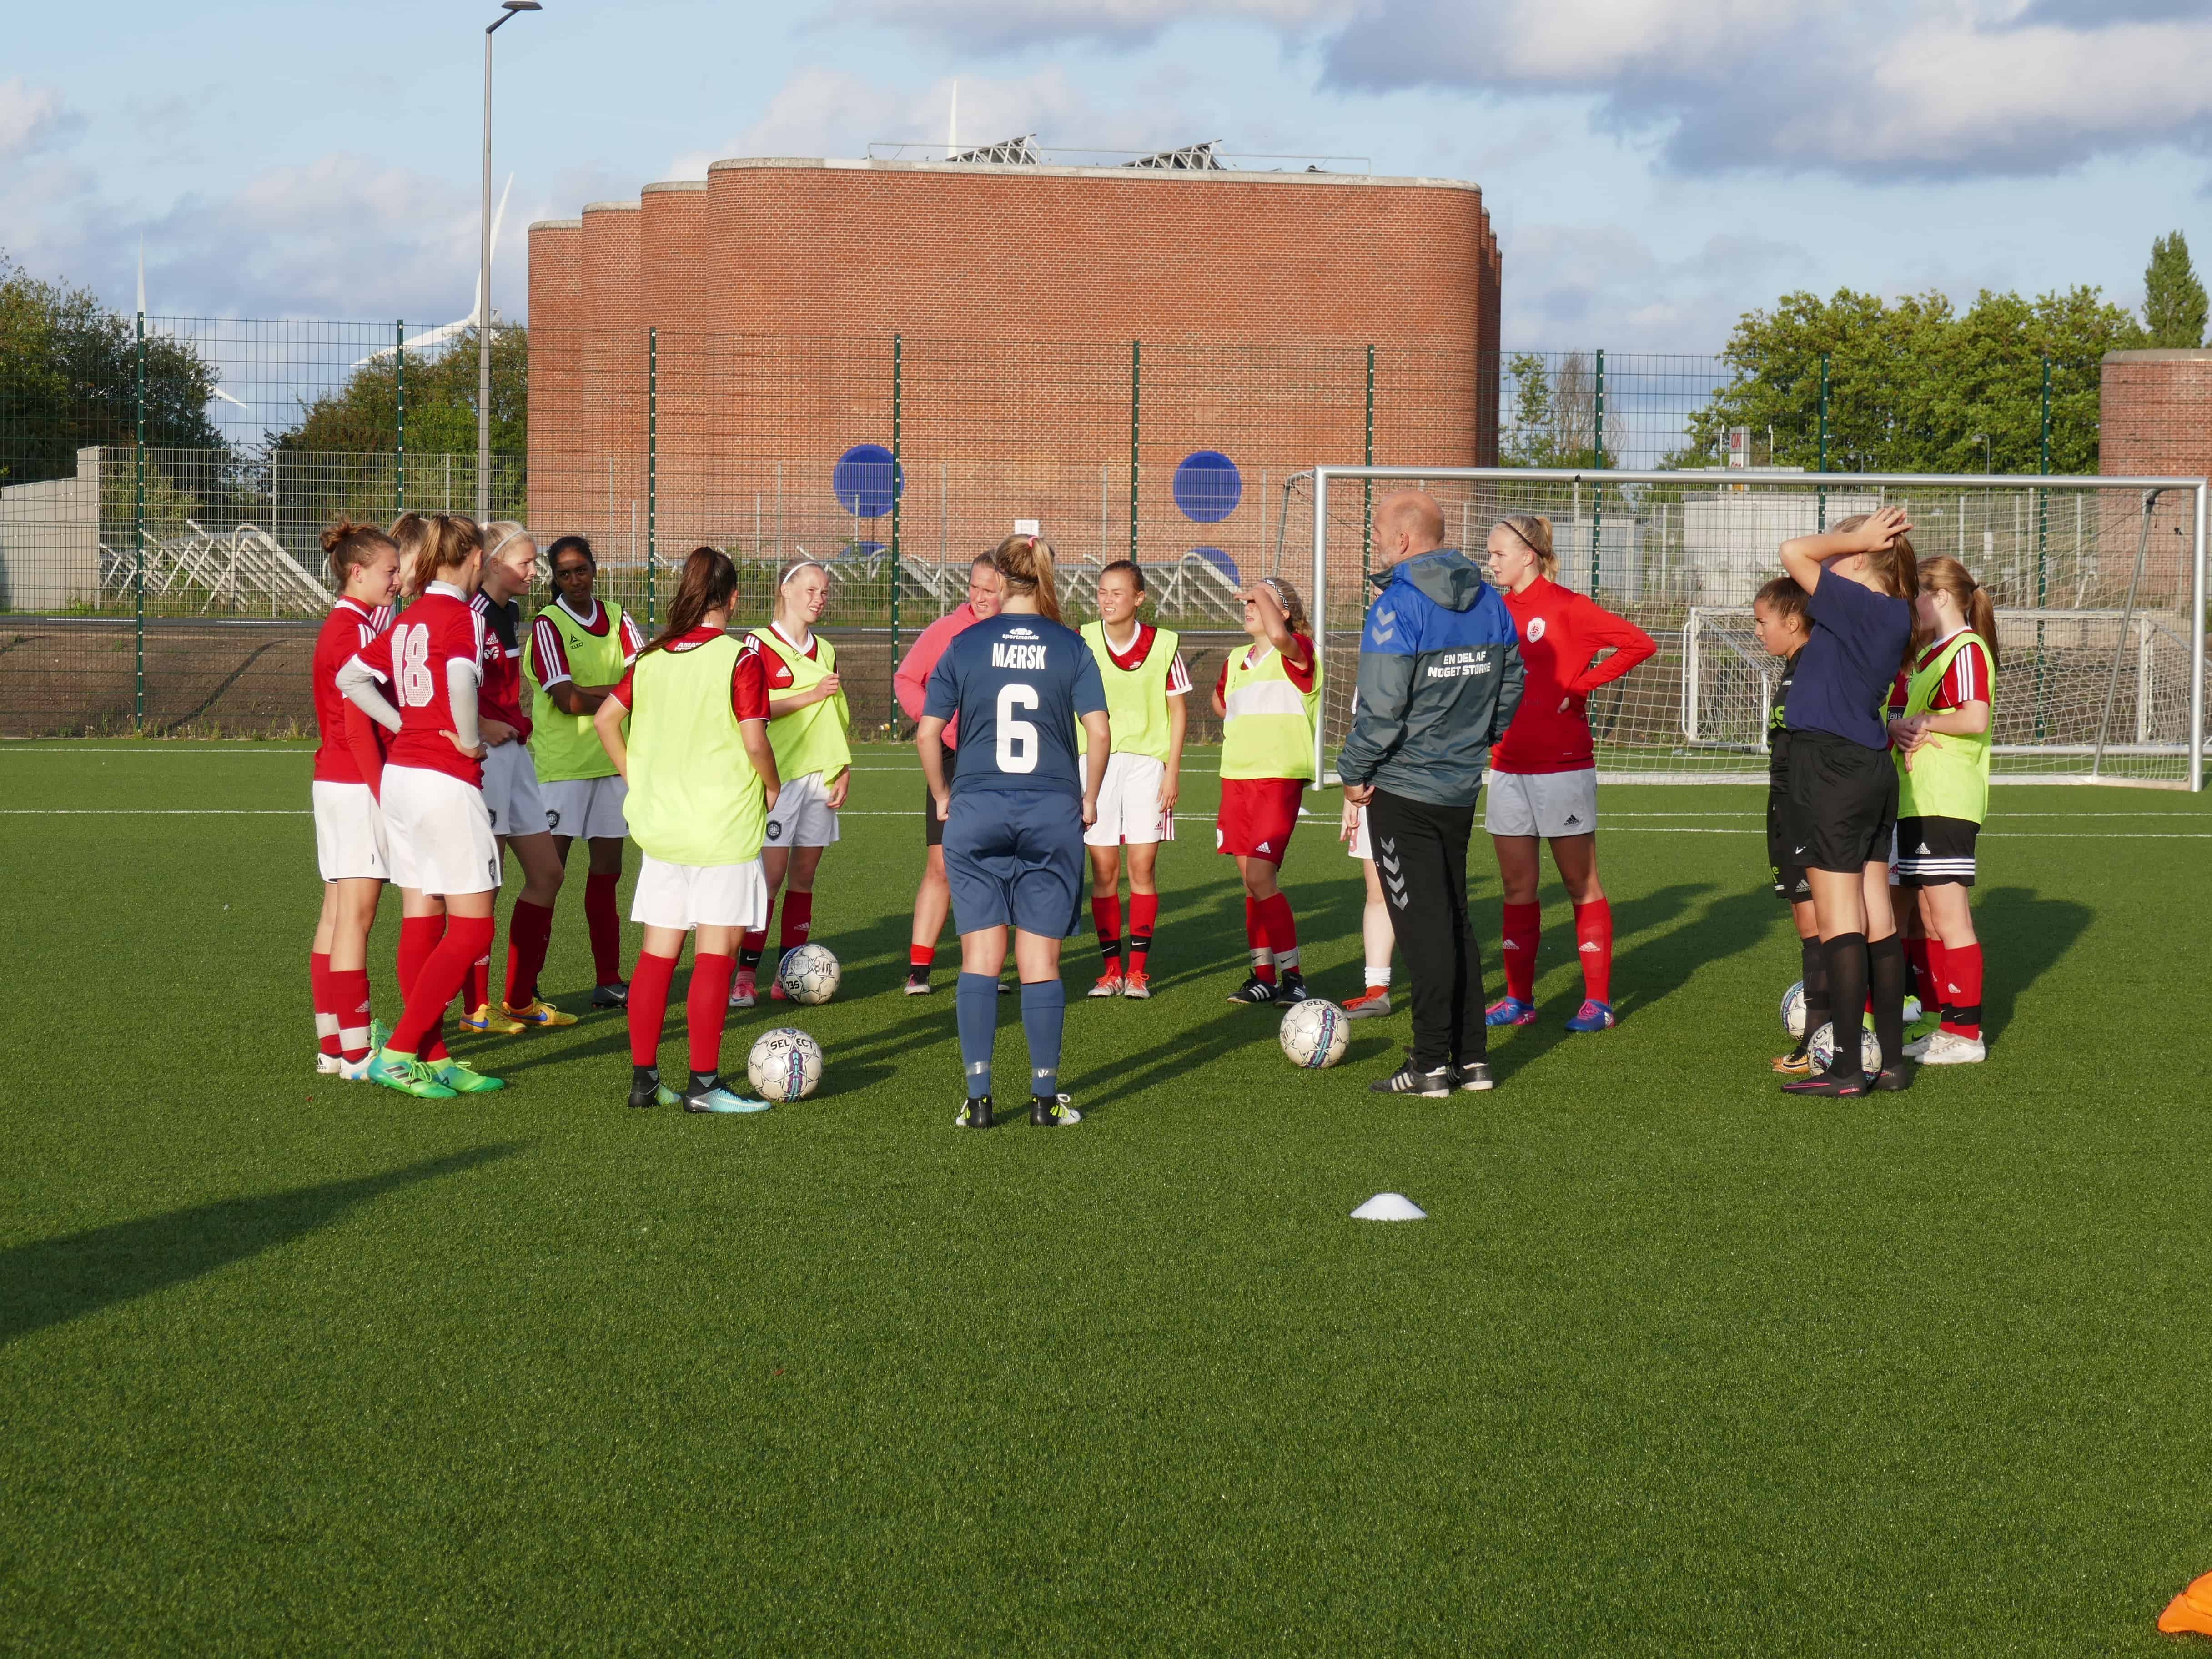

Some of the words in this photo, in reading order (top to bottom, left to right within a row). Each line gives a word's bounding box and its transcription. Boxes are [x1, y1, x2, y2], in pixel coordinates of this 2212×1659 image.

[1731, 433, 1741, 448] OK
[391, 623, 434, 707] 18
[992, 643, 1047, 669] MÆRSK
[1443, 654, 1455, 664] EN
[1457, 653, 1474, 664] DEL
[1476, 651, 1486, 661] AF
[1428, 666, 1461, 677] NOGET
[1462, 662, 1490, 675] STØRRE
[996, 684, 1039, 773] 6
